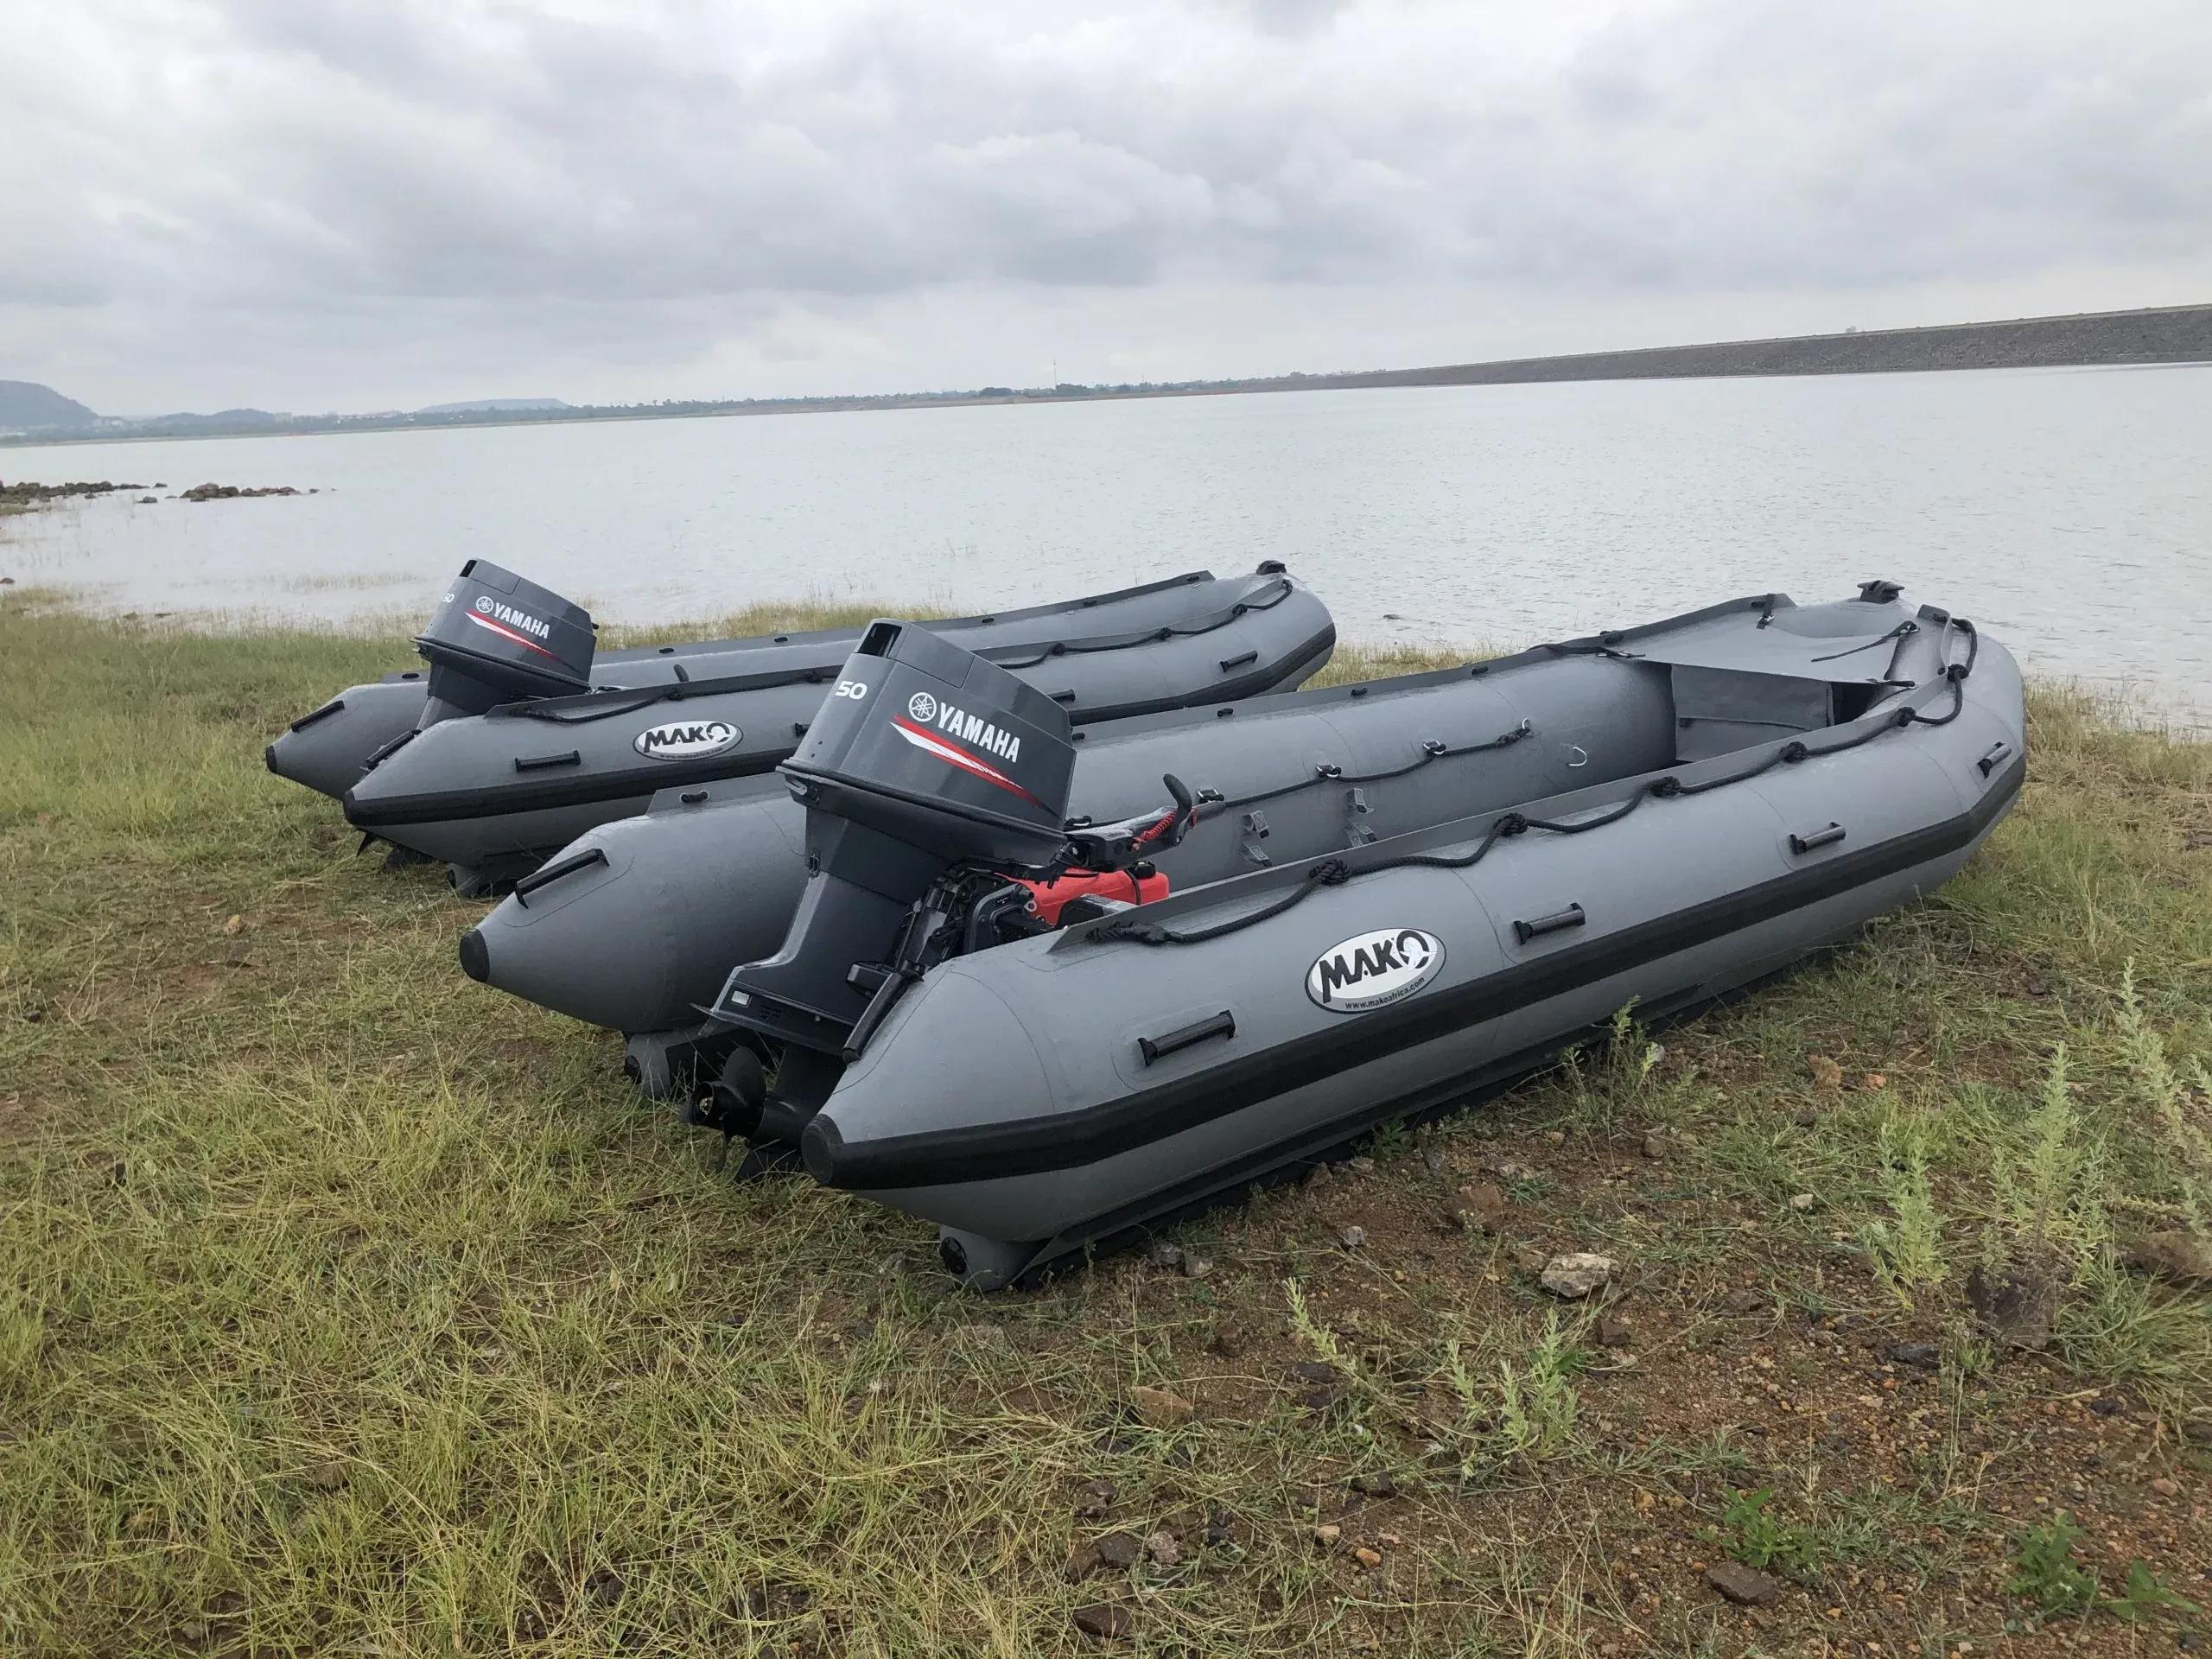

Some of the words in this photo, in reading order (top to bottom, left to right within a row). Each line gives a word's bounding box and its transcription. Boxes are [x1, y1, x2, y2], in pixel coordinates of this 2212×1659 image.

[493, 601, 550, 639] YAMAHA
[835, 680, 868, 700] 50
[644, 721, 731, 753] MAKO
[938, 702, 1020, 763] YAMAHA
[1319, 930, 1430, 1004] MAKO
[1344, 976, 1426, 1010] www.makoafrica.com
